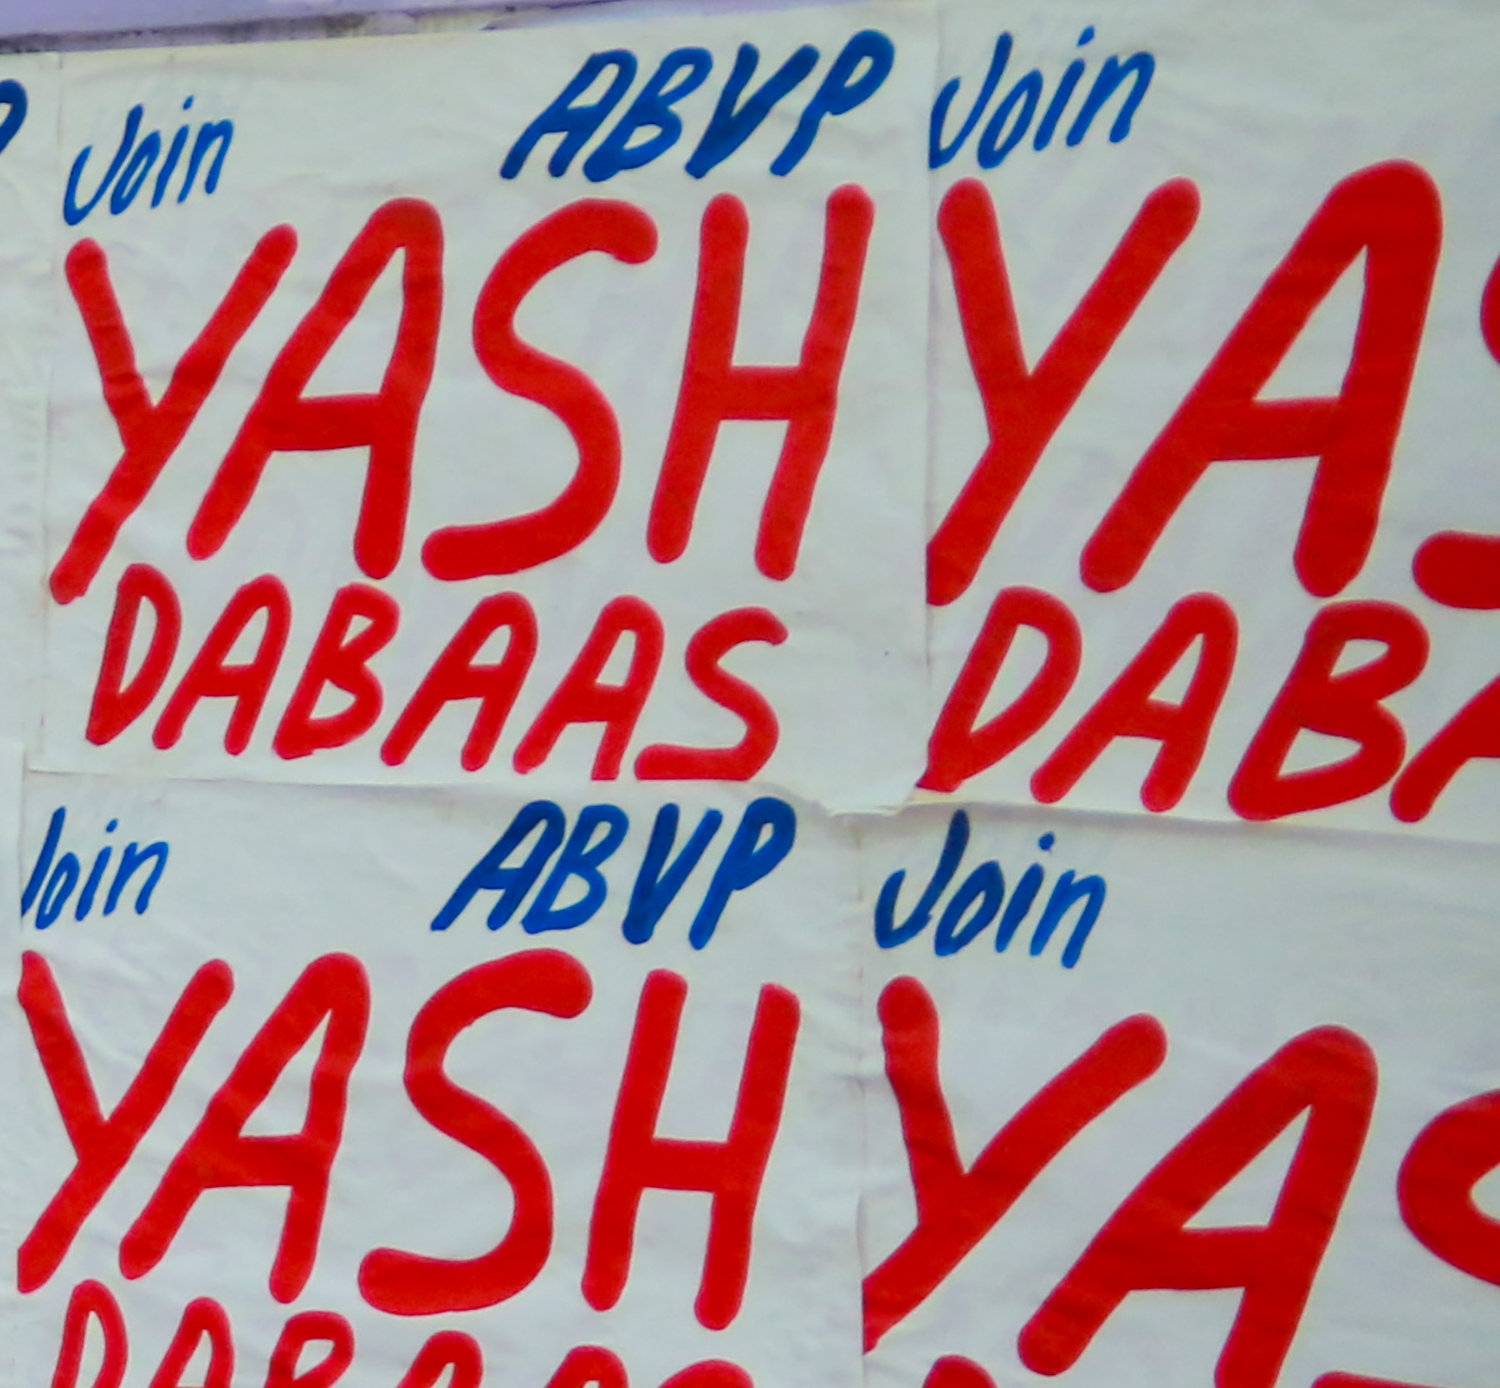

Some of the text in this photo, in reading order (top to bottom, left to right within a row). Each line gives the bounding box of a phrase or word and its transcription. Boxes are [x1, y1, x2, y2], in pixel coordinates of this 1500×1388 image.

[63, 30, 896, 226] Join ABVP
[928, 26, 1156, 170] Join
[48, 183, 874, 604] YASH
[84, 563, 788, 781] DABAAS
[430, 796, 797, 951] ABVP
[874, 810, 1106, 968] Join
[17, 948, 801, 1331] YASH
